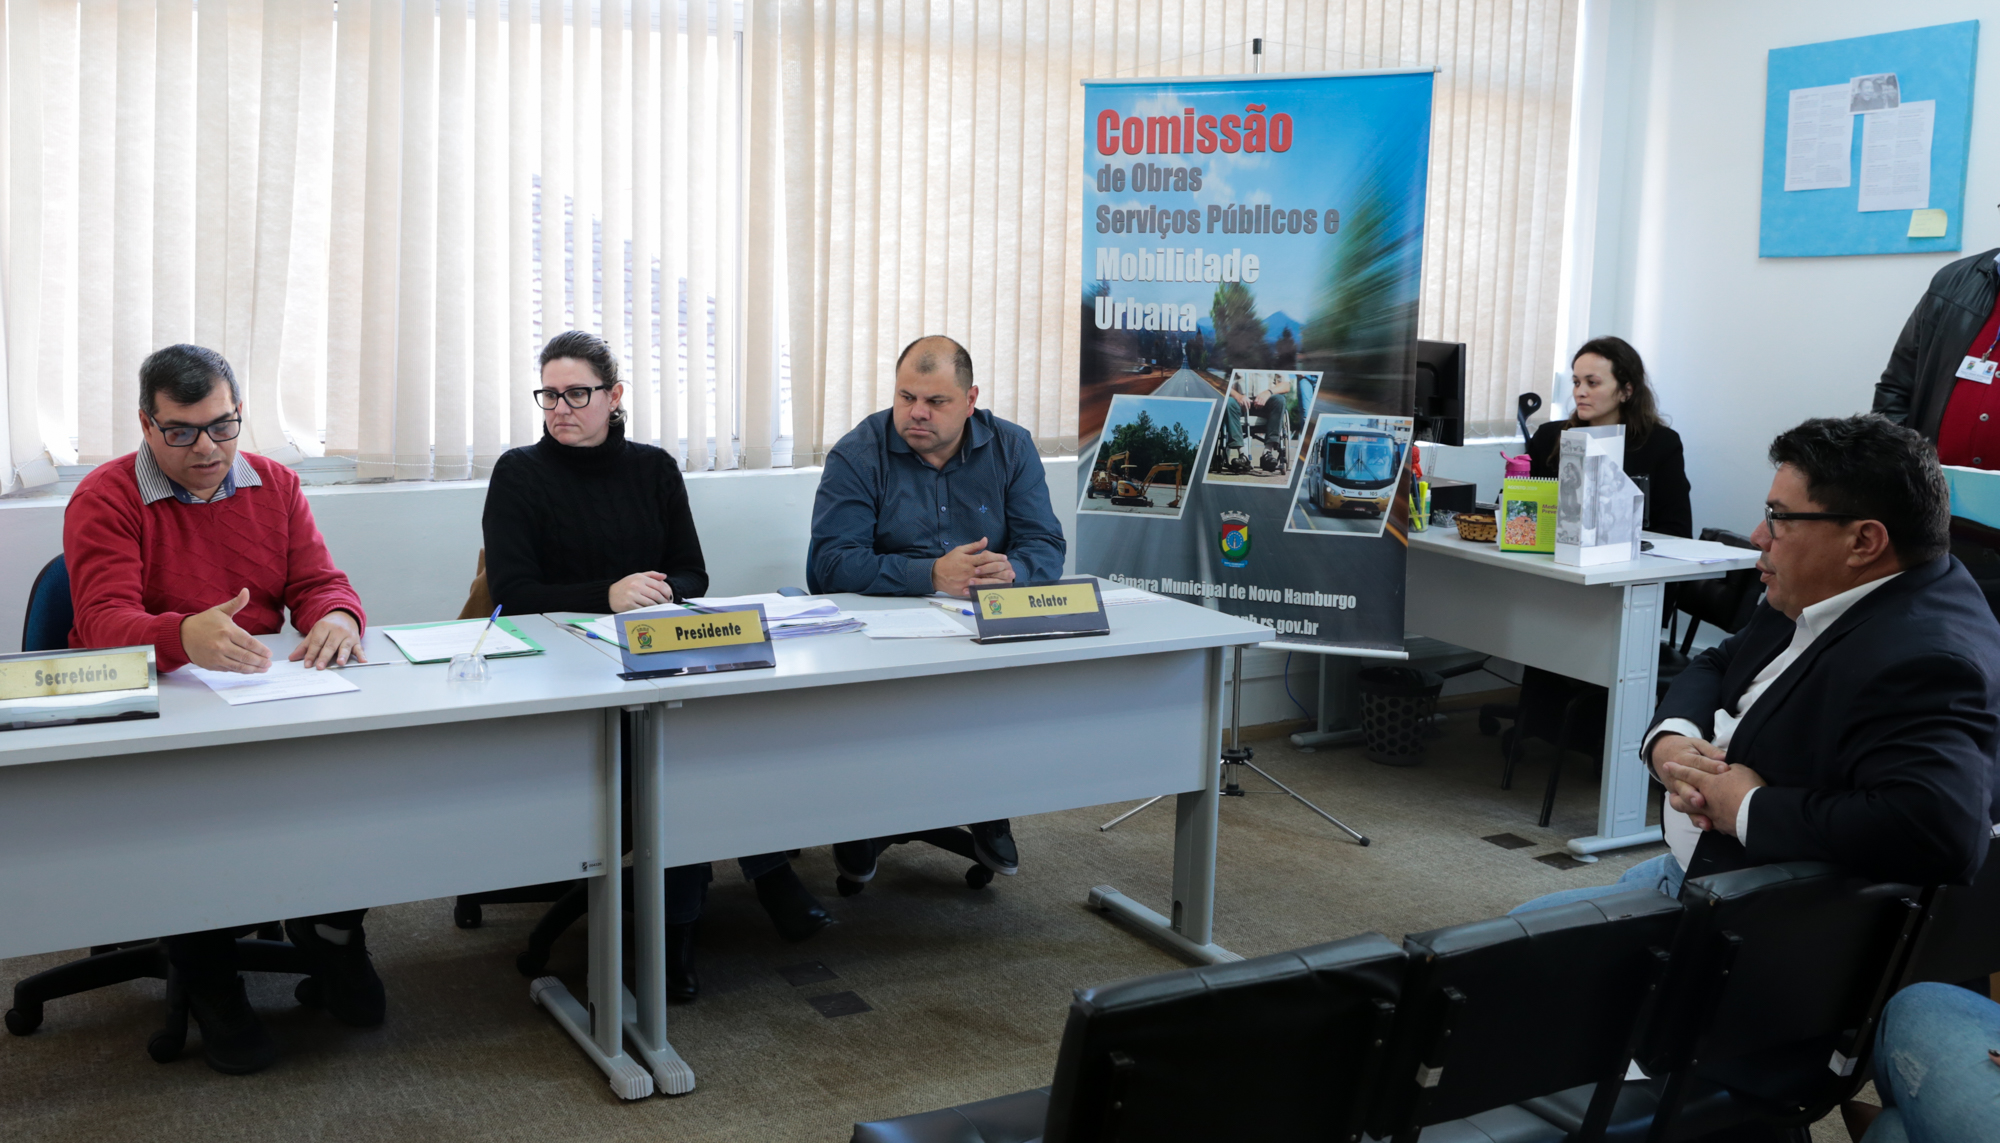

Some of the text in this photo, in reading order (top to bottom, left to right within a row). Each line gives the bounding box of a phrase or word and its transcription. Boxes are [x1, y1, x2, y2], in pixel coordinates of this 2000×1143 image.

[1097, 103, 1293, 156] Comissão
[1097, 162, 1203, 193] de Obras
[1096, 203, 1340, 239] Serviços Públicos e
[1095, 247, 1260, 283] Mobilidade
[1094, 295, 1197, 332] Urbana
[1028, 594, 1068, 608] Relator
[1161, 578, 1227, 599] Municipal
[1229, 583, 1246, 600] de
[1249, 585, 1282, 603] Novo
[1284, 588, 1357, 610] Hamburgo
[675, 622, 742, 641] Presidente
[35, 664, 118, 686] Secretário
